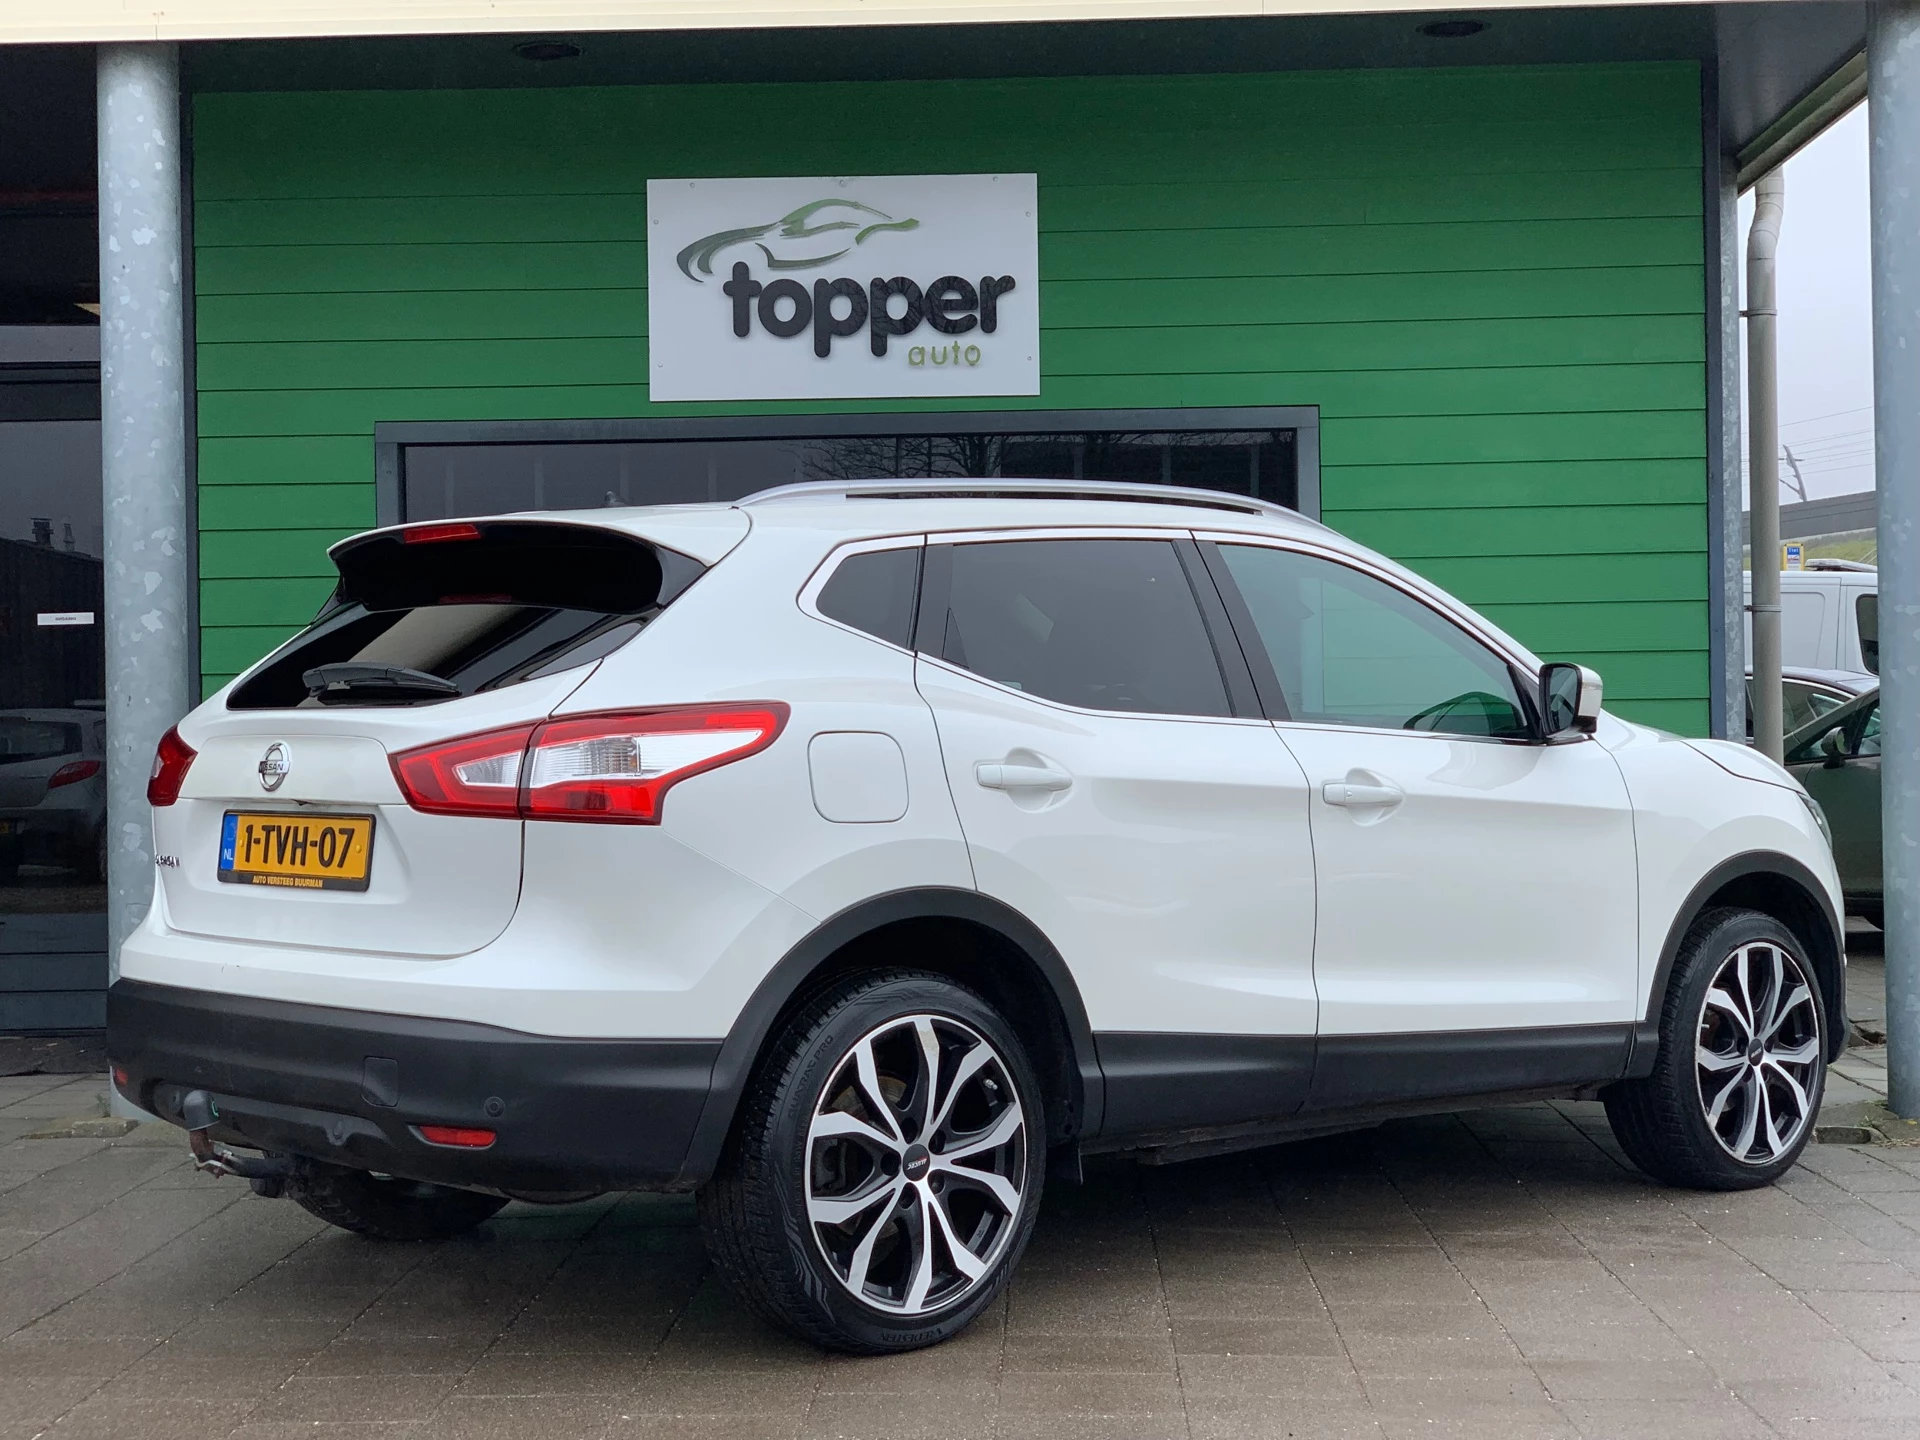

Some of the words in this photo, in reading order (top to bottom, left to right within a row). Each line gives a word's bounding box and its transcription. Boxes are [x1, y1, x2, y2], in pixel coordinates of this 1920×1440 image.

[722, 261, 1016, 358] topper
[907, 340, 981, 366] auto
[223, 848, 233, 861] NL
[244, 824, 355, 868] 1-TVH-07
[252, 875, 266, 884] AUTO
[267, 876, 294, 886] VERSTEEG
[294, 877, 323, 888] BUURMAN
